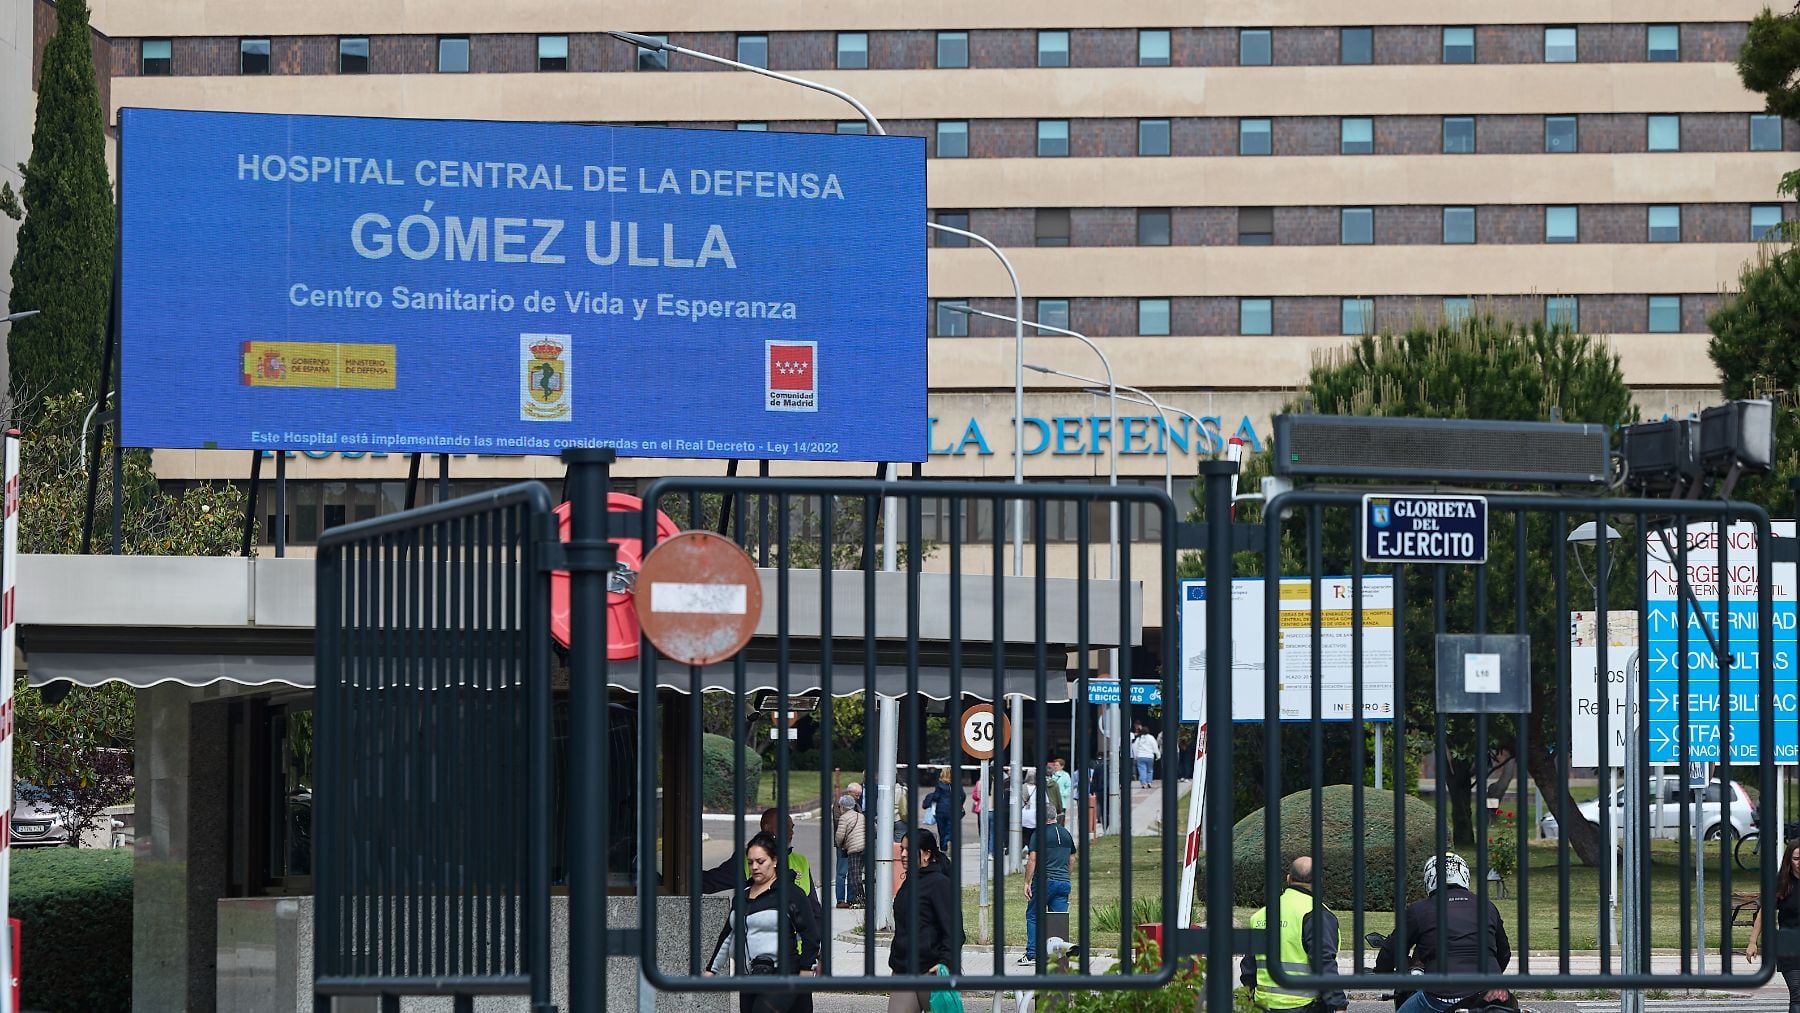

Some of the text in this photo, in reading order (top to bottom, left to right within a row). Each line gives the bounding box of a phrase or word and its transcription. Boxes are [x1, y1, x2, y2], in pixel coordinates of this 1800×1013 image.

[237, 153, 845, 200] HOSPITAL CENTRAL DE LA DEFENSA
[350, 200, 737, 269] GÓMEZ ULLA
[288, 283, 797, 322] Centro Sanitario de Vida y Esperanza
[291, 358, 330, 366] GOBIERNO
[291, 365, 330, 373] DE ESPAÑA
[345, 359, 386, 367] MINISTERIO
[345, 366, 388, 375] DE DEFENSA
[770, 392, 814, 400] Comunidad
[783, 399, 814, 407] Madrid
[251, 431, 280, 443] Este
[284, 432, 338, 446] Hospital
[341, 432, 369, 445] está
[372, 434, 471, 447] implementando
[474, 435, 493, 447] las
[496, 436, 550, 448] medidas
[553, 437, 638, 450] consideradas
[642, 440, 657, 450] en
[661, 439, 672, 450] el
[676, 439, 704, 451] Real
[707, 440, 756, 452] Decreto
[767, 441, 789, 455] Ley
[793, 441, 839, 454] 14/2022
[928, 415, 1264, 456] LA DEFENSA
[1394, 500, 1476, 518] GLORIETA
[1413, 518, 1440, 531] DEL
[1377, 531, 1474, 557] EJERCITO
[1667, 531, 1780, 550] URGENCI
[1667, 565, 1759, 583] URGENCI
[1668, 584, 1787, 596] MERN INFATIL
[1671, 611, 1797, 630] MATERNIAD
[1671, 651, 1789, 670] CONULTS
[1094, 694, 1143, 703] BICICLAS
[1578, 698, 1610, 715] Re
[1672, 693, 1797, 712] REHABILIAC
[971, 721, 995, 742] 30
[1672, 745, 1738, 757] DNACIN
[1740, 745, 1758, 757] DE
